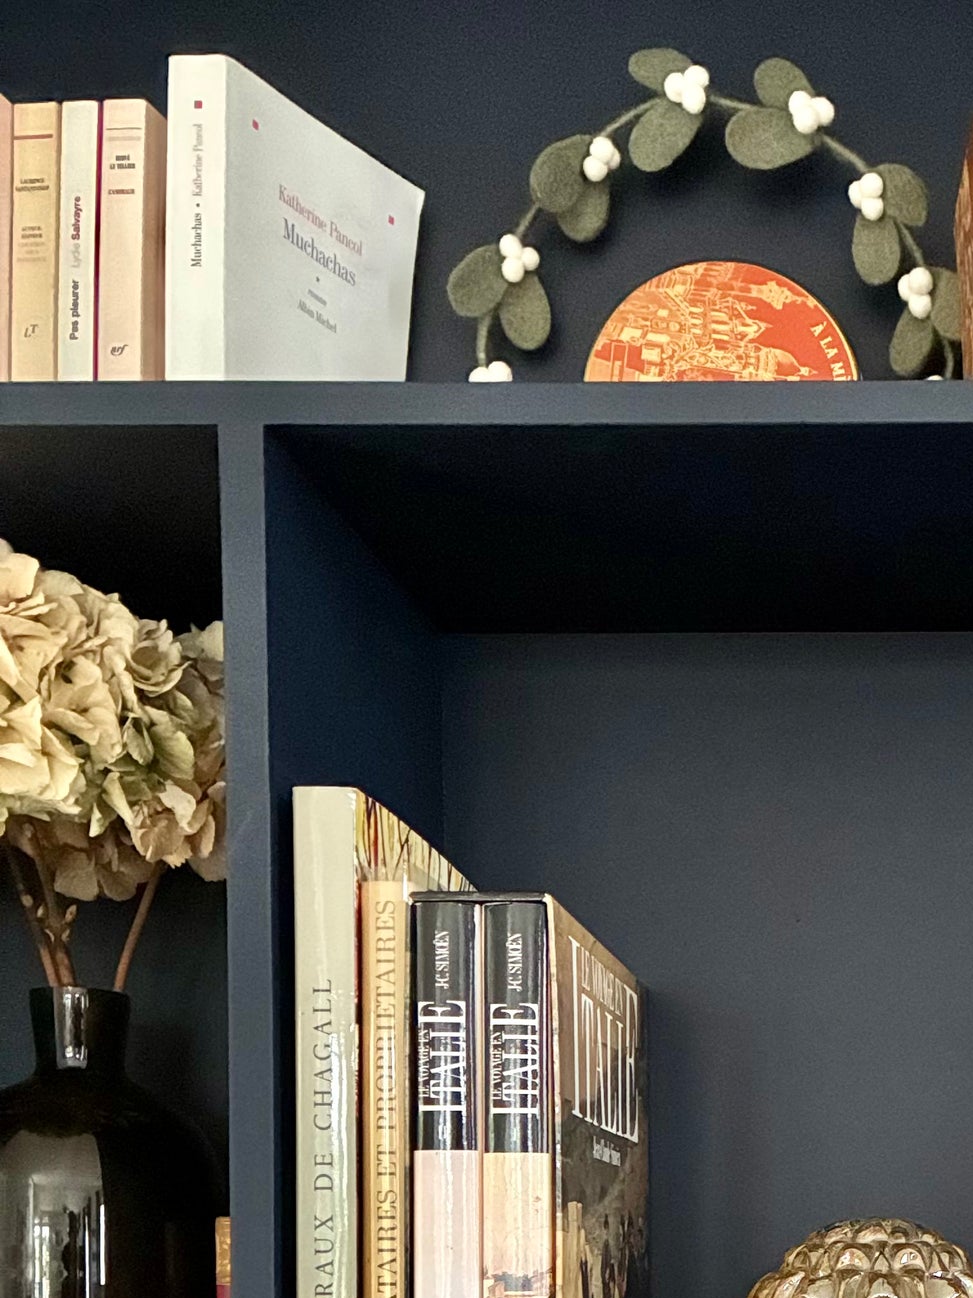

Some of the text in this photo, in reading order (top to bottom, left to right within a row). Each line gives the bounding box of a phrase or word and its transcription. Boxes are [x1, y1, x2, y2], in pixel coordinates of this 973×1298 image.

[190, 124, 204, 267] Muchachas Katherine Pancol
[278, 183, 364, 257] Katherine Pancol
[69, 196, 83, 340] Pas pleurer Salvayre
[282, 217, 356, 287] Muchachas
[316, 310, 337, 333] Michel
[810, 321, 839, 359] À LA
[312, 979, 333, 1131] CHAGALL
[375, 900, 398, 1132] PROPRIETAIRES
[418, 1000, 466, 1112] ITALIE
[490, 1002, 539, 1115] ITALIE
[568, 936, 639, 1144] ITALIE
[491, 1048, 502, 1100] LE VOYAGE
[314, 1152, 334, 1192] DE
[377, 1144, 397, 1178] ET
